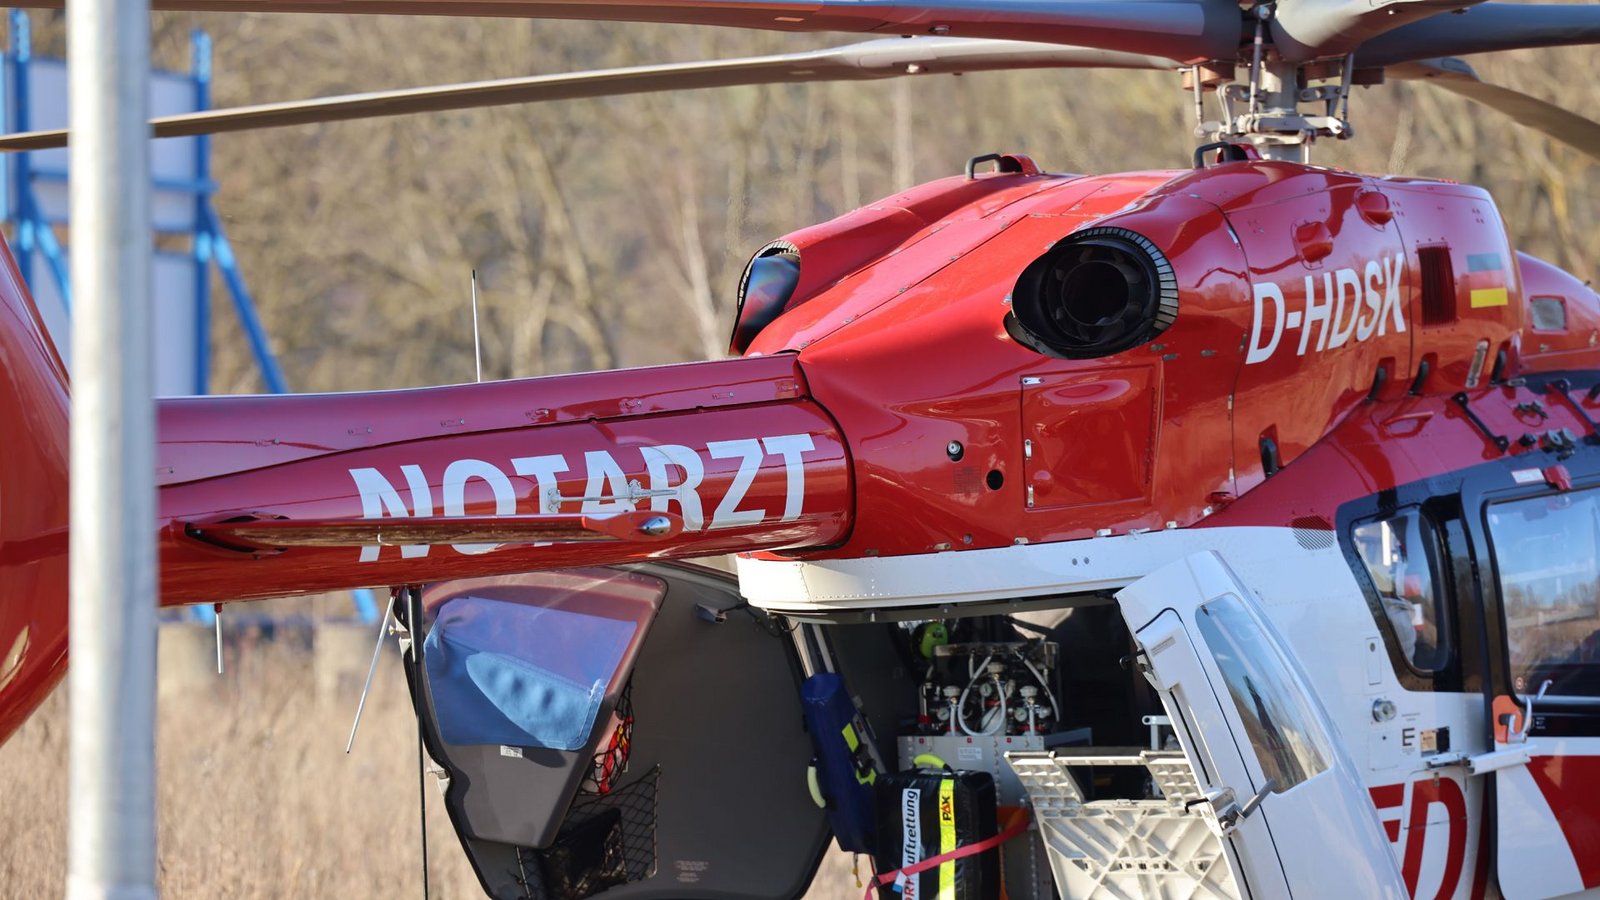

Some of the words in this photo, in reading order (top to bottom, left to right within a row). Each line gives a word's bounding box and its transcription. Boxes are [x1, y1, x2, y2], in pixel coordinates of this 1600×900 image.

[1245, 252, 1406, 364] D-HDSK
[348, 434, 816, 562] NOTARZT
[904, 790, 918, 865] uftrettung
[940, 795, 951, 821] PAX
